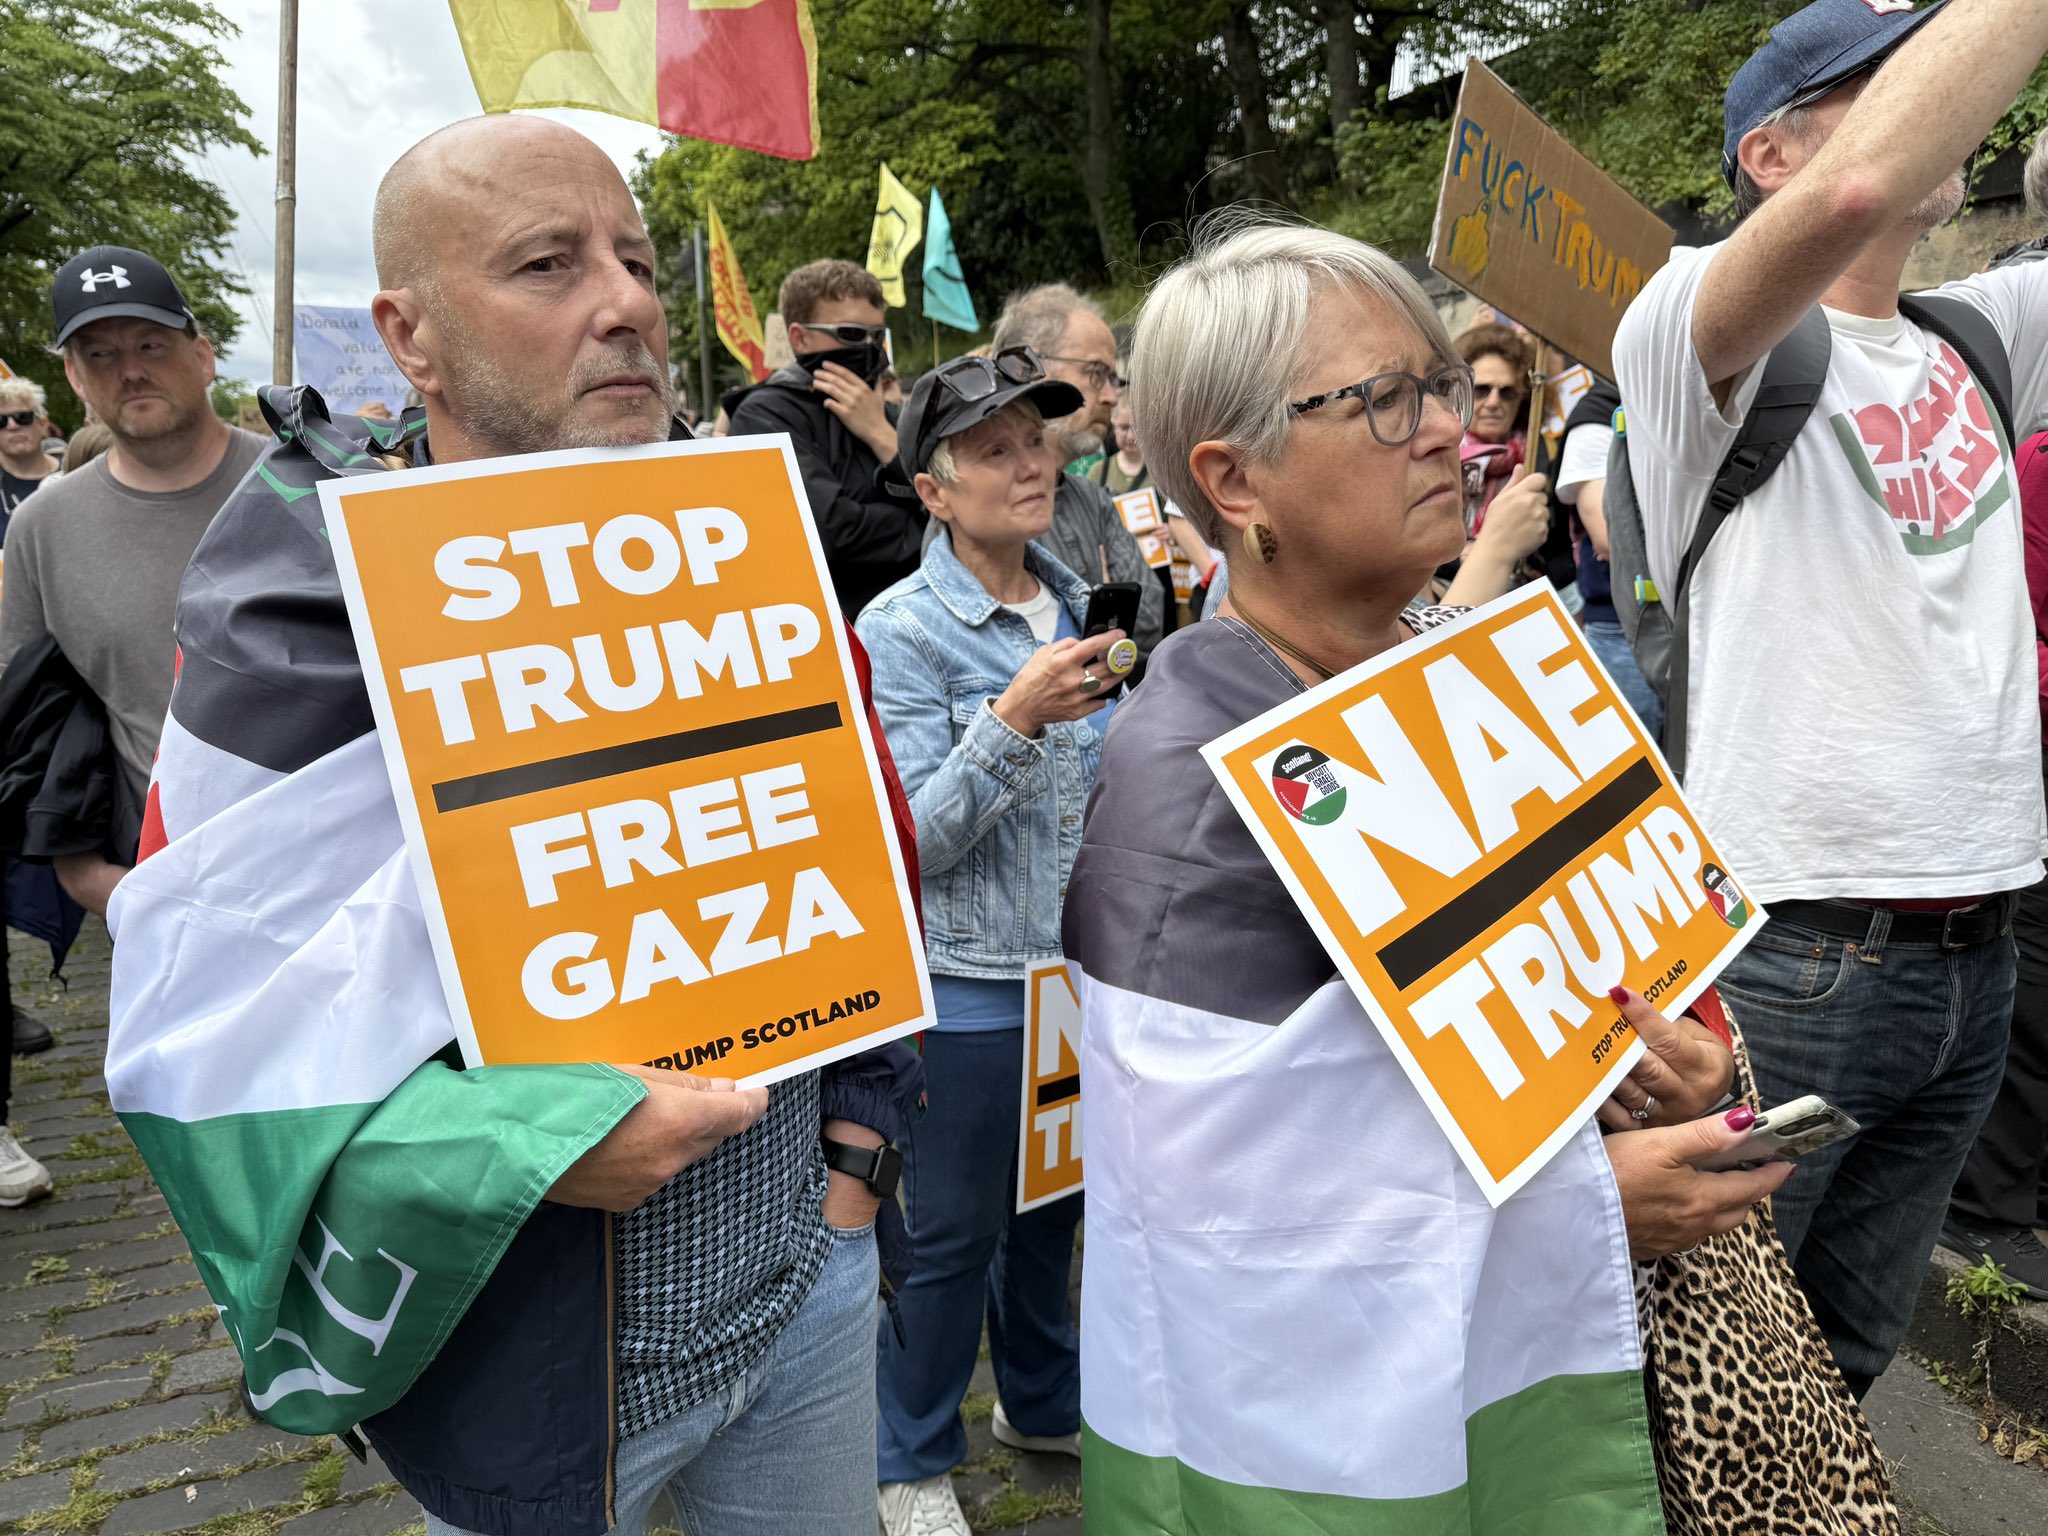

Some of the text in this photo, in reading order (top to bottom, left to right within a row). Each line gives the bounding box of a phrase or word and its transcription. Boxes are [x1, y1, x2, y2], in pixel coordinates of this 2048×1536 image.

[1453, 118, 1649, 308] FUCK TRUM
[434, 506, 748, 621] STOP
[399, 603, 821, 746] TRUMP
[1251, 606, 1637, 938] NAE
[1281, 752, 1312, 774] Scotland!
[1304, 763, 1330, 783] BOYCOTT
[1312, 771, 1336, 790] ISRAELI
[1319, 780, 1340, 796] GOODS
[510, 763, 818, 908] FREE
[521, 867, 865, 1020] GAZA
[1407, 805, 1706, 1100] TRUMP
[639, 990, 881, 1071] RUMP SCOTLAND
[1591, 959, 1688, 1064] STOP TRU COTLAND
